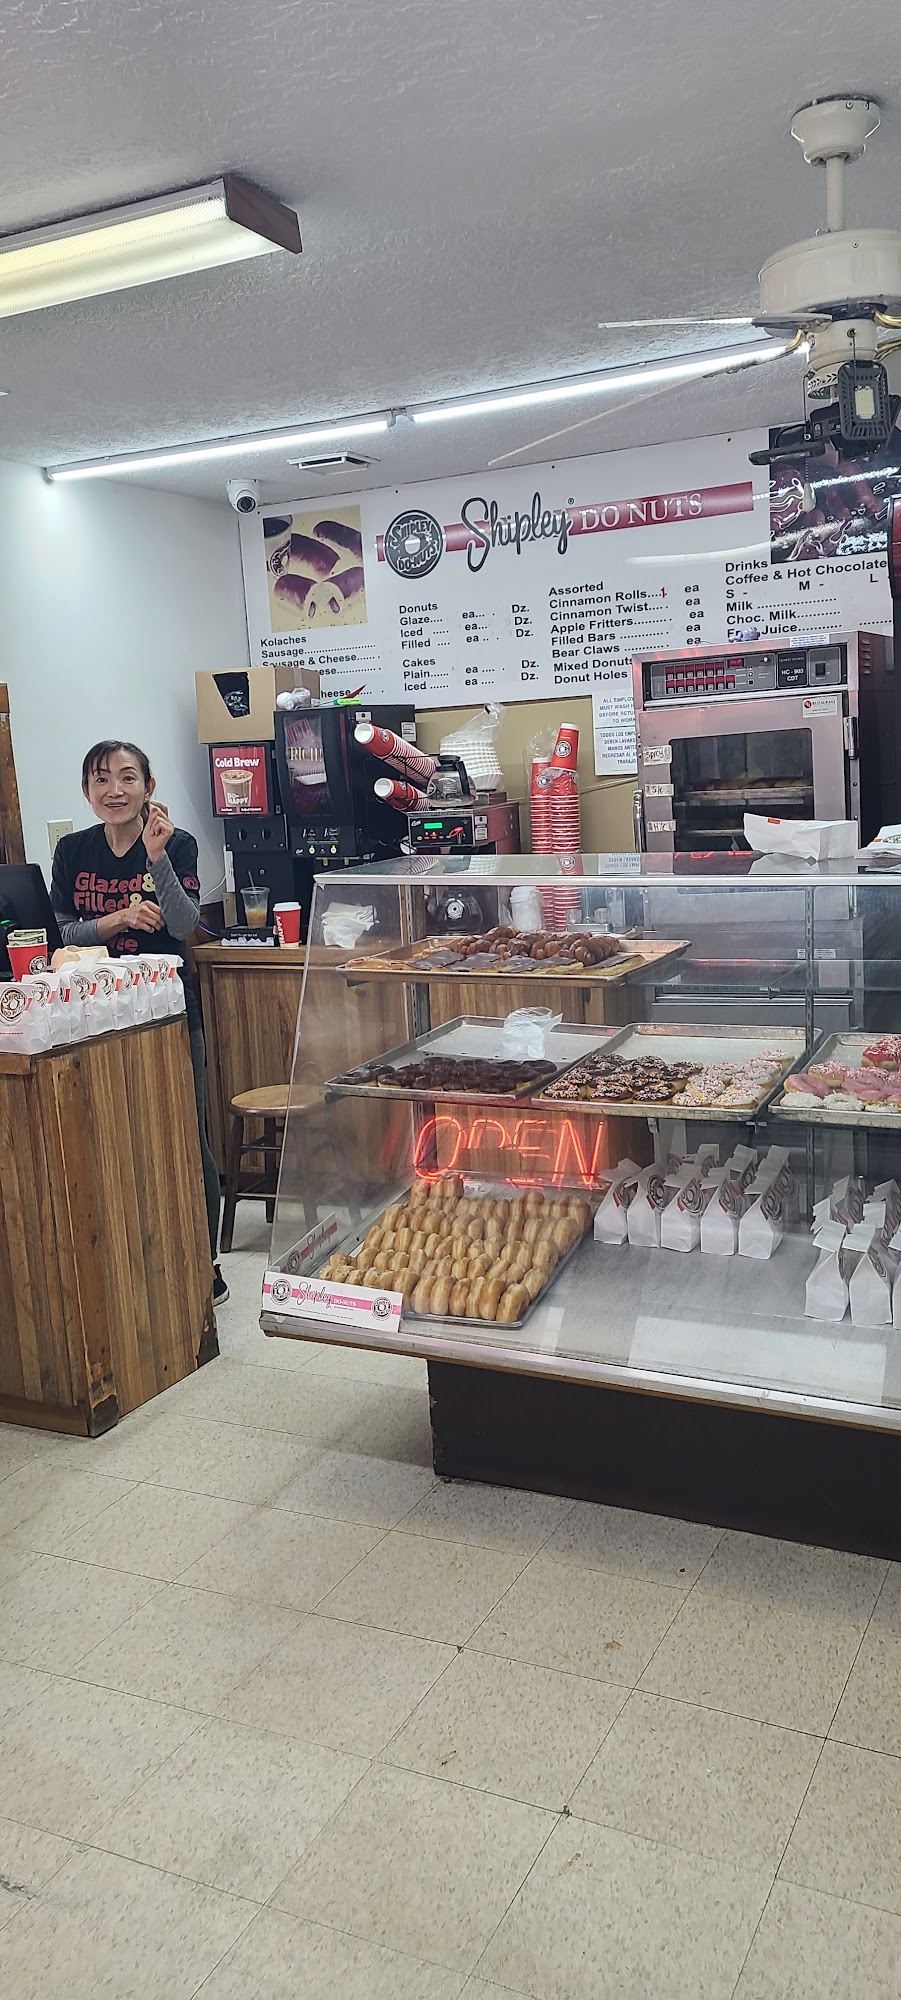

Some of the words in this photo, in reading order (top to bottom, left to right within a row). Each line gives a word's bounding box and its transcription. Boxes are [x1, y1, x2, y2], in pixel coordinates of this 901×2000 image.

[580, 506, 620, 531] DO
[626, 493, 703, 524] NUTS
[391, 520, 431, 549] SHIPLEY
[725, 560, 768, 573] Drinks
[725, 573, 769, 586] Coffee
[773, 571, 783, 580] &
[787, 567, 811, 579] Hot
[815, 559, 887, 575] Chocolate
[548, 581, 604, 597] Assorted
[726, 589, 735, 599] S
[799, 581, 810, 591] M
[870, 573, 878, 583] L
[549, 595, 612, 609] Cinnamon
[684, 584, 699, 593] ea
[399, 602, 438, 614] Donuts
[511, 604, 530, 613] Dz.
[549, 607, 612, 621] Cinnamon
[685, 597, 700, 606] ea
[726, 600, 753, 612] Milk
[400, 627, 423, 638] Iced
[514, 616, 532, 625] Dz.
[550, 622, 586, 635] Apple
[689, 610, 704, 619] ea
[726, 613, 765, 625] Choc.
[260, 635, 307, 647] Kolaches
[401, 638, 431, 650] Filled
[466, 635, 479, 643] ea
[515, 628, 534, 638] Dz.
[551, 634, 584, 647] Filled
[587, 632, 616, 643] Bars
[686, 624, 701, 632] ea
[552, 649, 580, 659] Bear
[583, 644, 620, 656] Claws
[686, 637, 701, 645] ea
[308, 657, 316, 666] &
[402, 658, 436, 668] Cakes
[465, 666, 479, 674] ea
[521, 660, 539, 669] Dz.
[553, 660, 588, 673] Mixed
[404, 681, 427, 691] Iced
[465, 678, 478, 686] ea
[520, 672, 539, 681] Dz.
[554, 673, 590, 685] Donut
[594, 670, 628, 681] Holes
[215, 757, 233, 768] Cold
[233, 757, 260, 767] Brew
